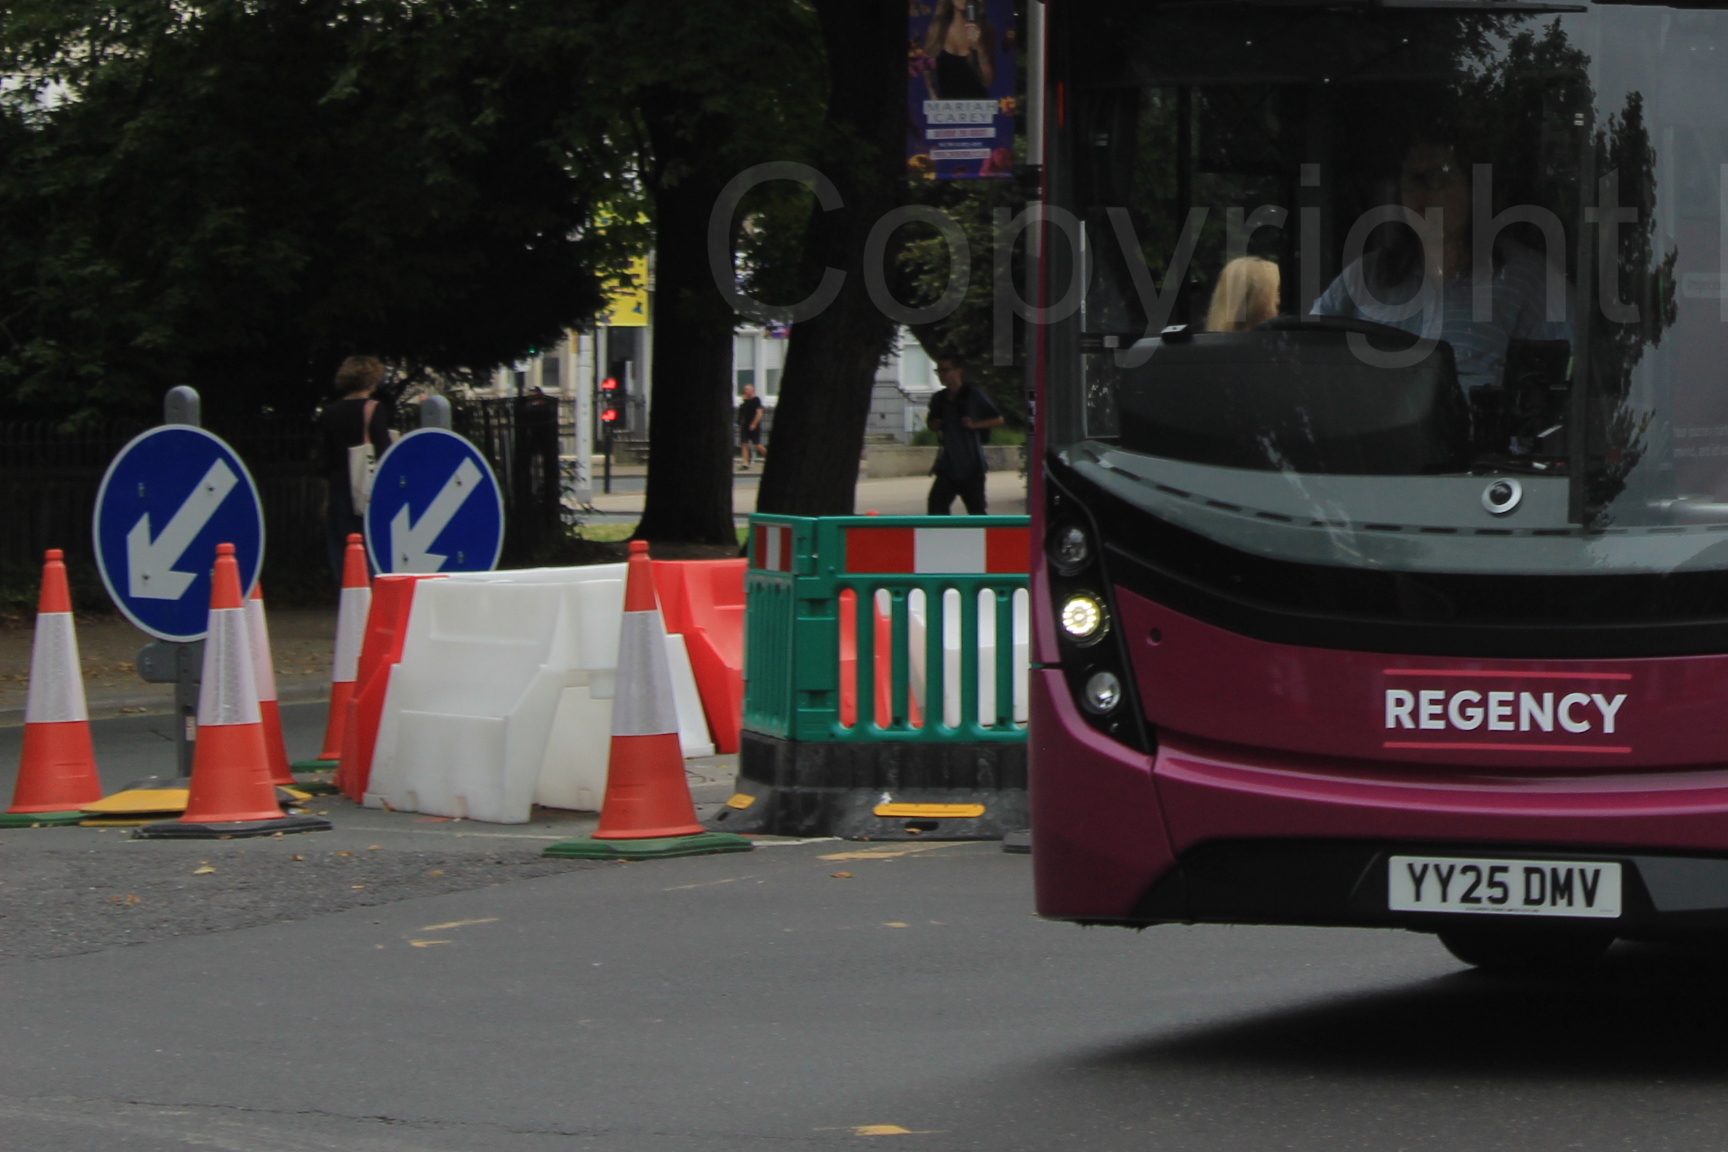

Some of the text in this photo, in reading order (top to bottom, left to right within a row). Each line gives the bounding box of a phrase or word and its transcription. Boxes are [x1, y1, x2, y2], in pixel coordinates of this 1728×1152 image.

[925, 102, 998, 111] MARIAH
[934, 113, 988, 123] CAREY
[1385, 688, 1627, 734] REGENCY
[1407, 863, 1602, 908] YY25 DMV
